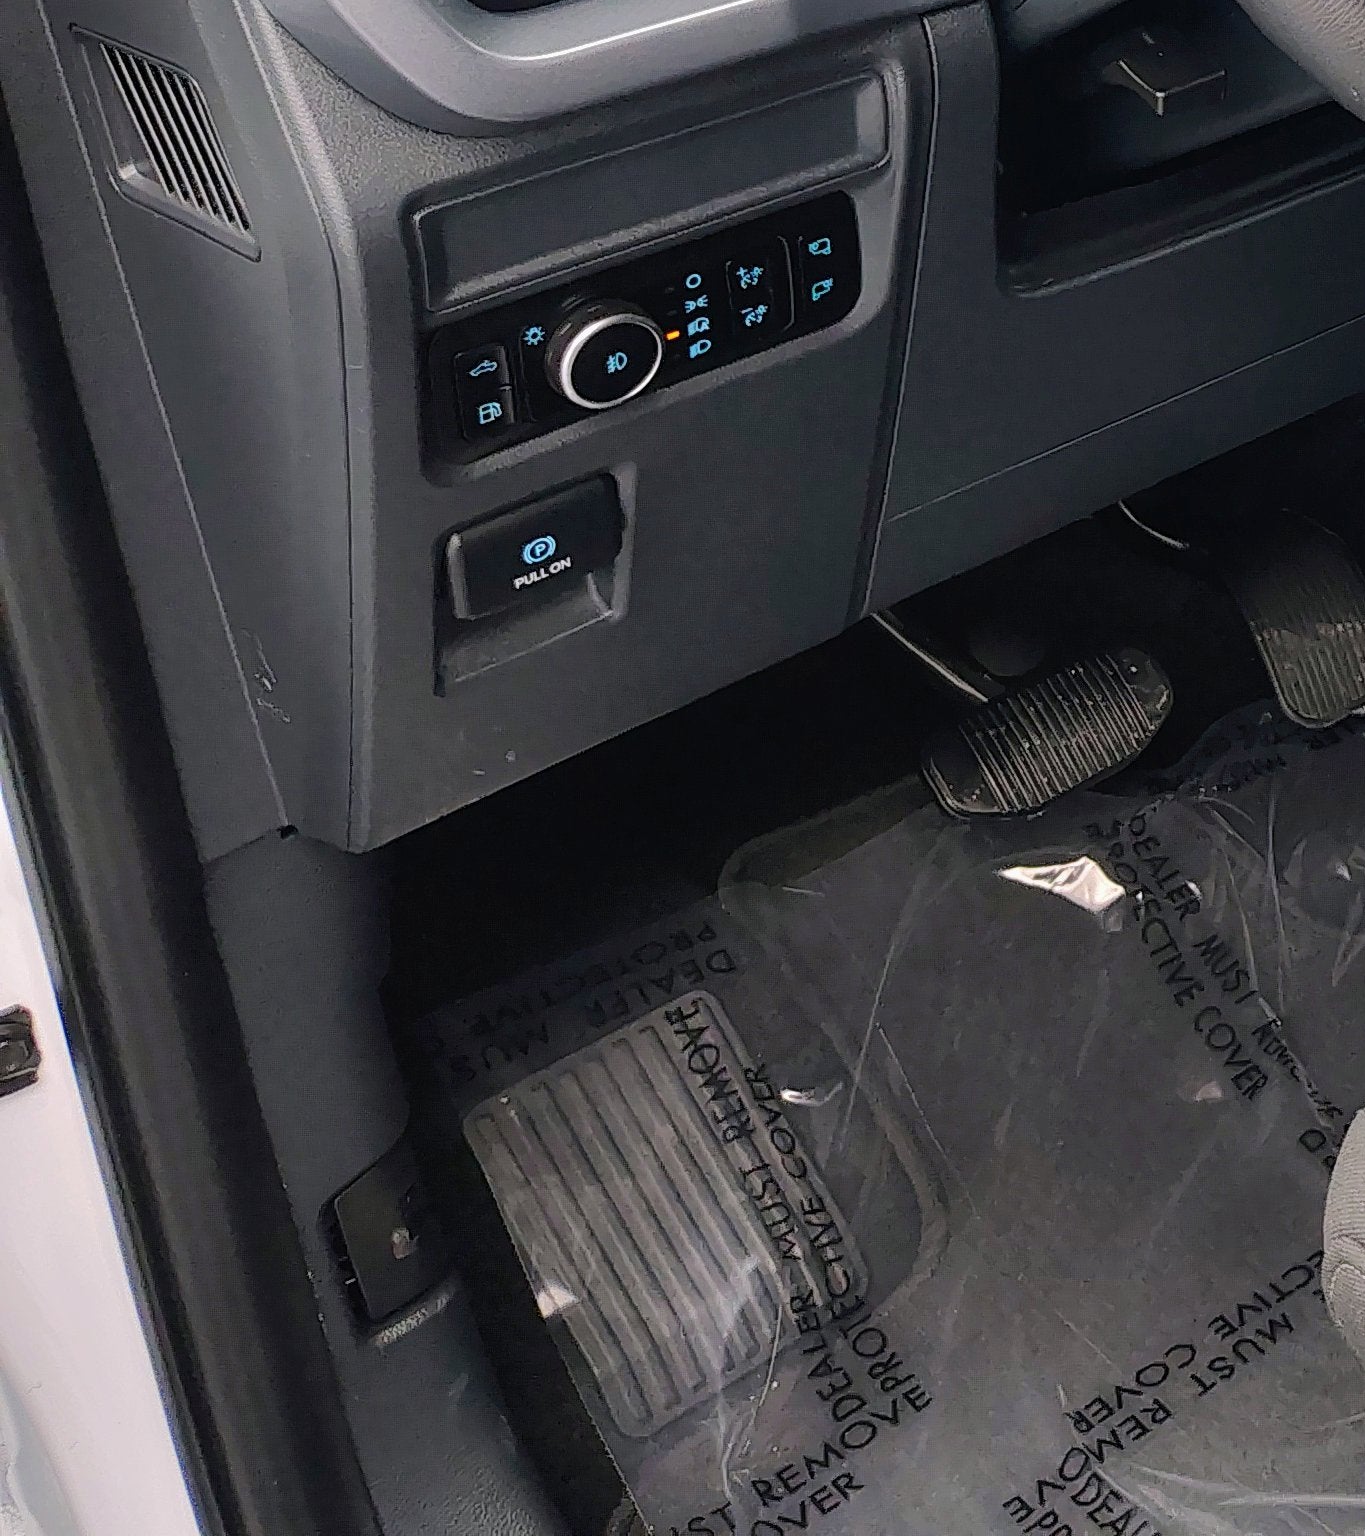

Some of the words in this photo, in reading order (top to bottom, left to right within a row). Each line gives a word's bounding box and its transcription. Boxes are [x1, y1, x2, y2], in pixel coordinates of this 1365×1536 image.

[513, 567, 549, 590] PULL
[549, 557, 571, 574] ON
[1192, 934, 1259, 1005] MUST
[1192, 1006, 1270, 1102] COVER
[743, 1065, 808, 1181] COVER
[741, 1160, 804, 1263] MUST
[789, 1288, 868, 1422] DEALER
[1062, 1343, 1198, 1436] COVER
[1188, 1312, 1296, 1400] MUST
[750, 1382, 934, 1506] REMOVE
[1002, 1397, 1174, 1526] REMOVE
